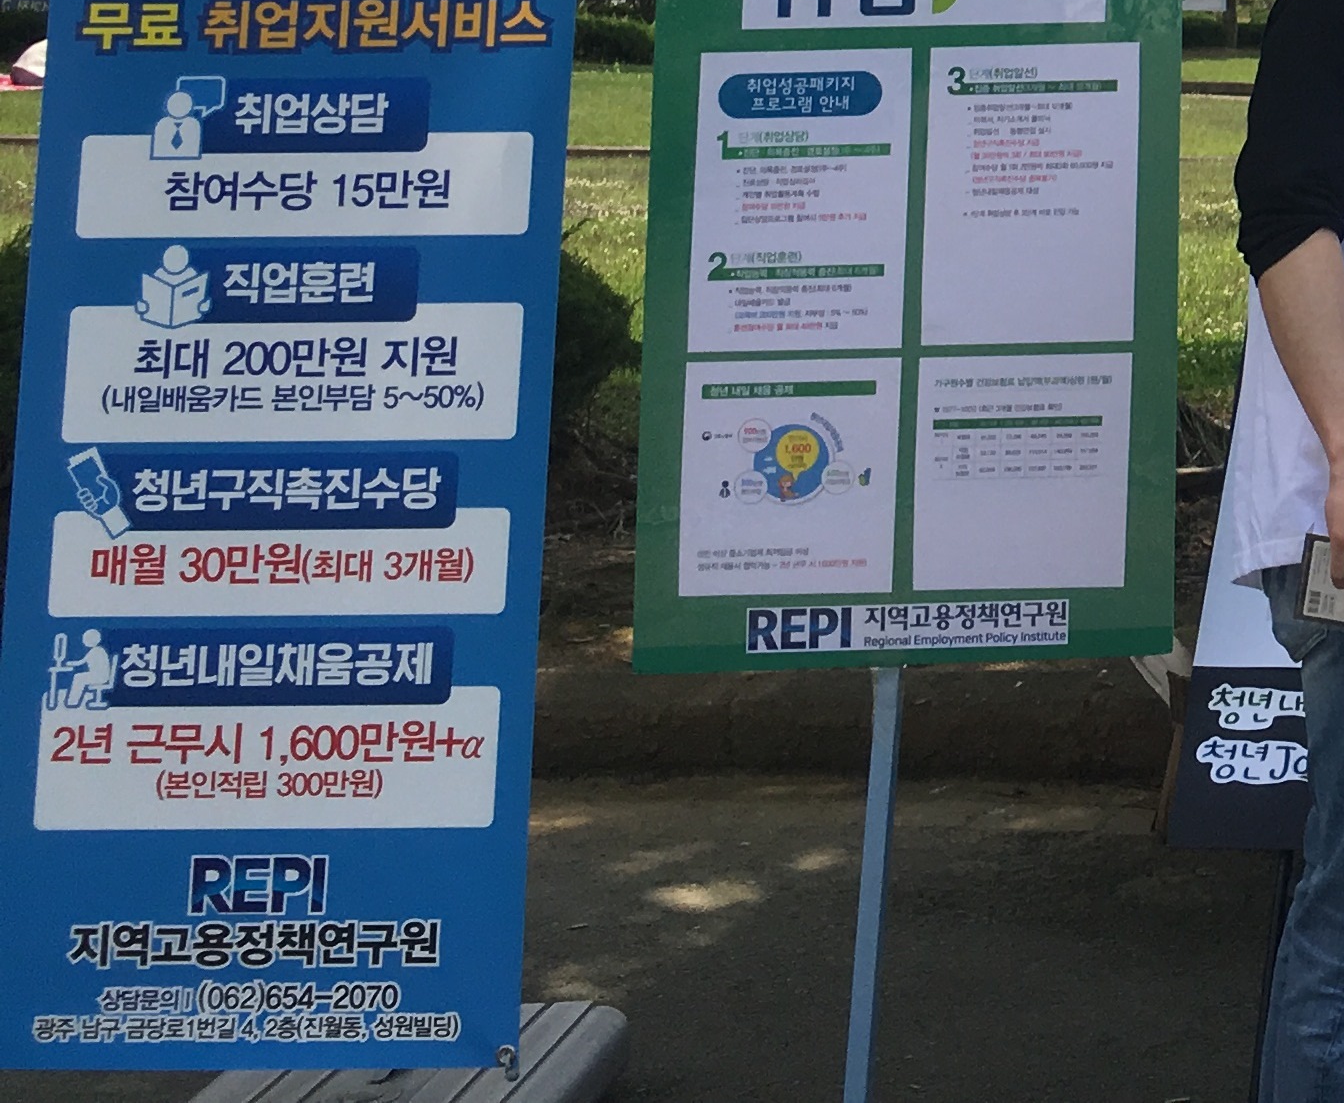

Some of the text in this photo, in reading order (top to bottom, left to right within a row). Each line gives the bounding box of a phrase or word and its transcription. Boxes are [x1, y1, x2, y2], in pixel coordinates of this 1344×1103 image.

[81, 2, 183, 49] 무료
[747, 76, 855, 95] 취업성공패키지
[751, 95, 849, 113] 프로그램 안내
[234, 93, 389, 135] 취업상담
[164, 169, 451, 211] 참여수당 15만원
[222, 262, 375, 304] 직업훈련
[134, 336, 458, 379] 최대 200만원 지원
[101, 384, 263, 414] (내일배움카드
[271, 384, 375, 412] 본인부담
[131, 468, 441, 510] 청년구직촉진수당
[90, 544, 165, 585] 매월
[384, 547, 474, 583] 3개월)
[748, 601, 1067, 651] REPI 지역고용정책연구원
[864, 630, 1067, 649] Regional Employment Policy Institute
[121, 642, 433, 688] 청년내일채움공제
[52, 724, 112, 765] 2년
[126, 723, 243, 764] 근무시
[156, 769, 383, 800] (본인적립 300만원)
[189, 855, 328, 915] REPI
[68, 921, 441, 967] 지역고용정책연구원
[101, 984, 399, 1014] 상담문의 (062)654-2070
[34, 1015, 460, 1040] 광주 남구 금당로1번길 4, 2층(진월동, 성원빌딩)
